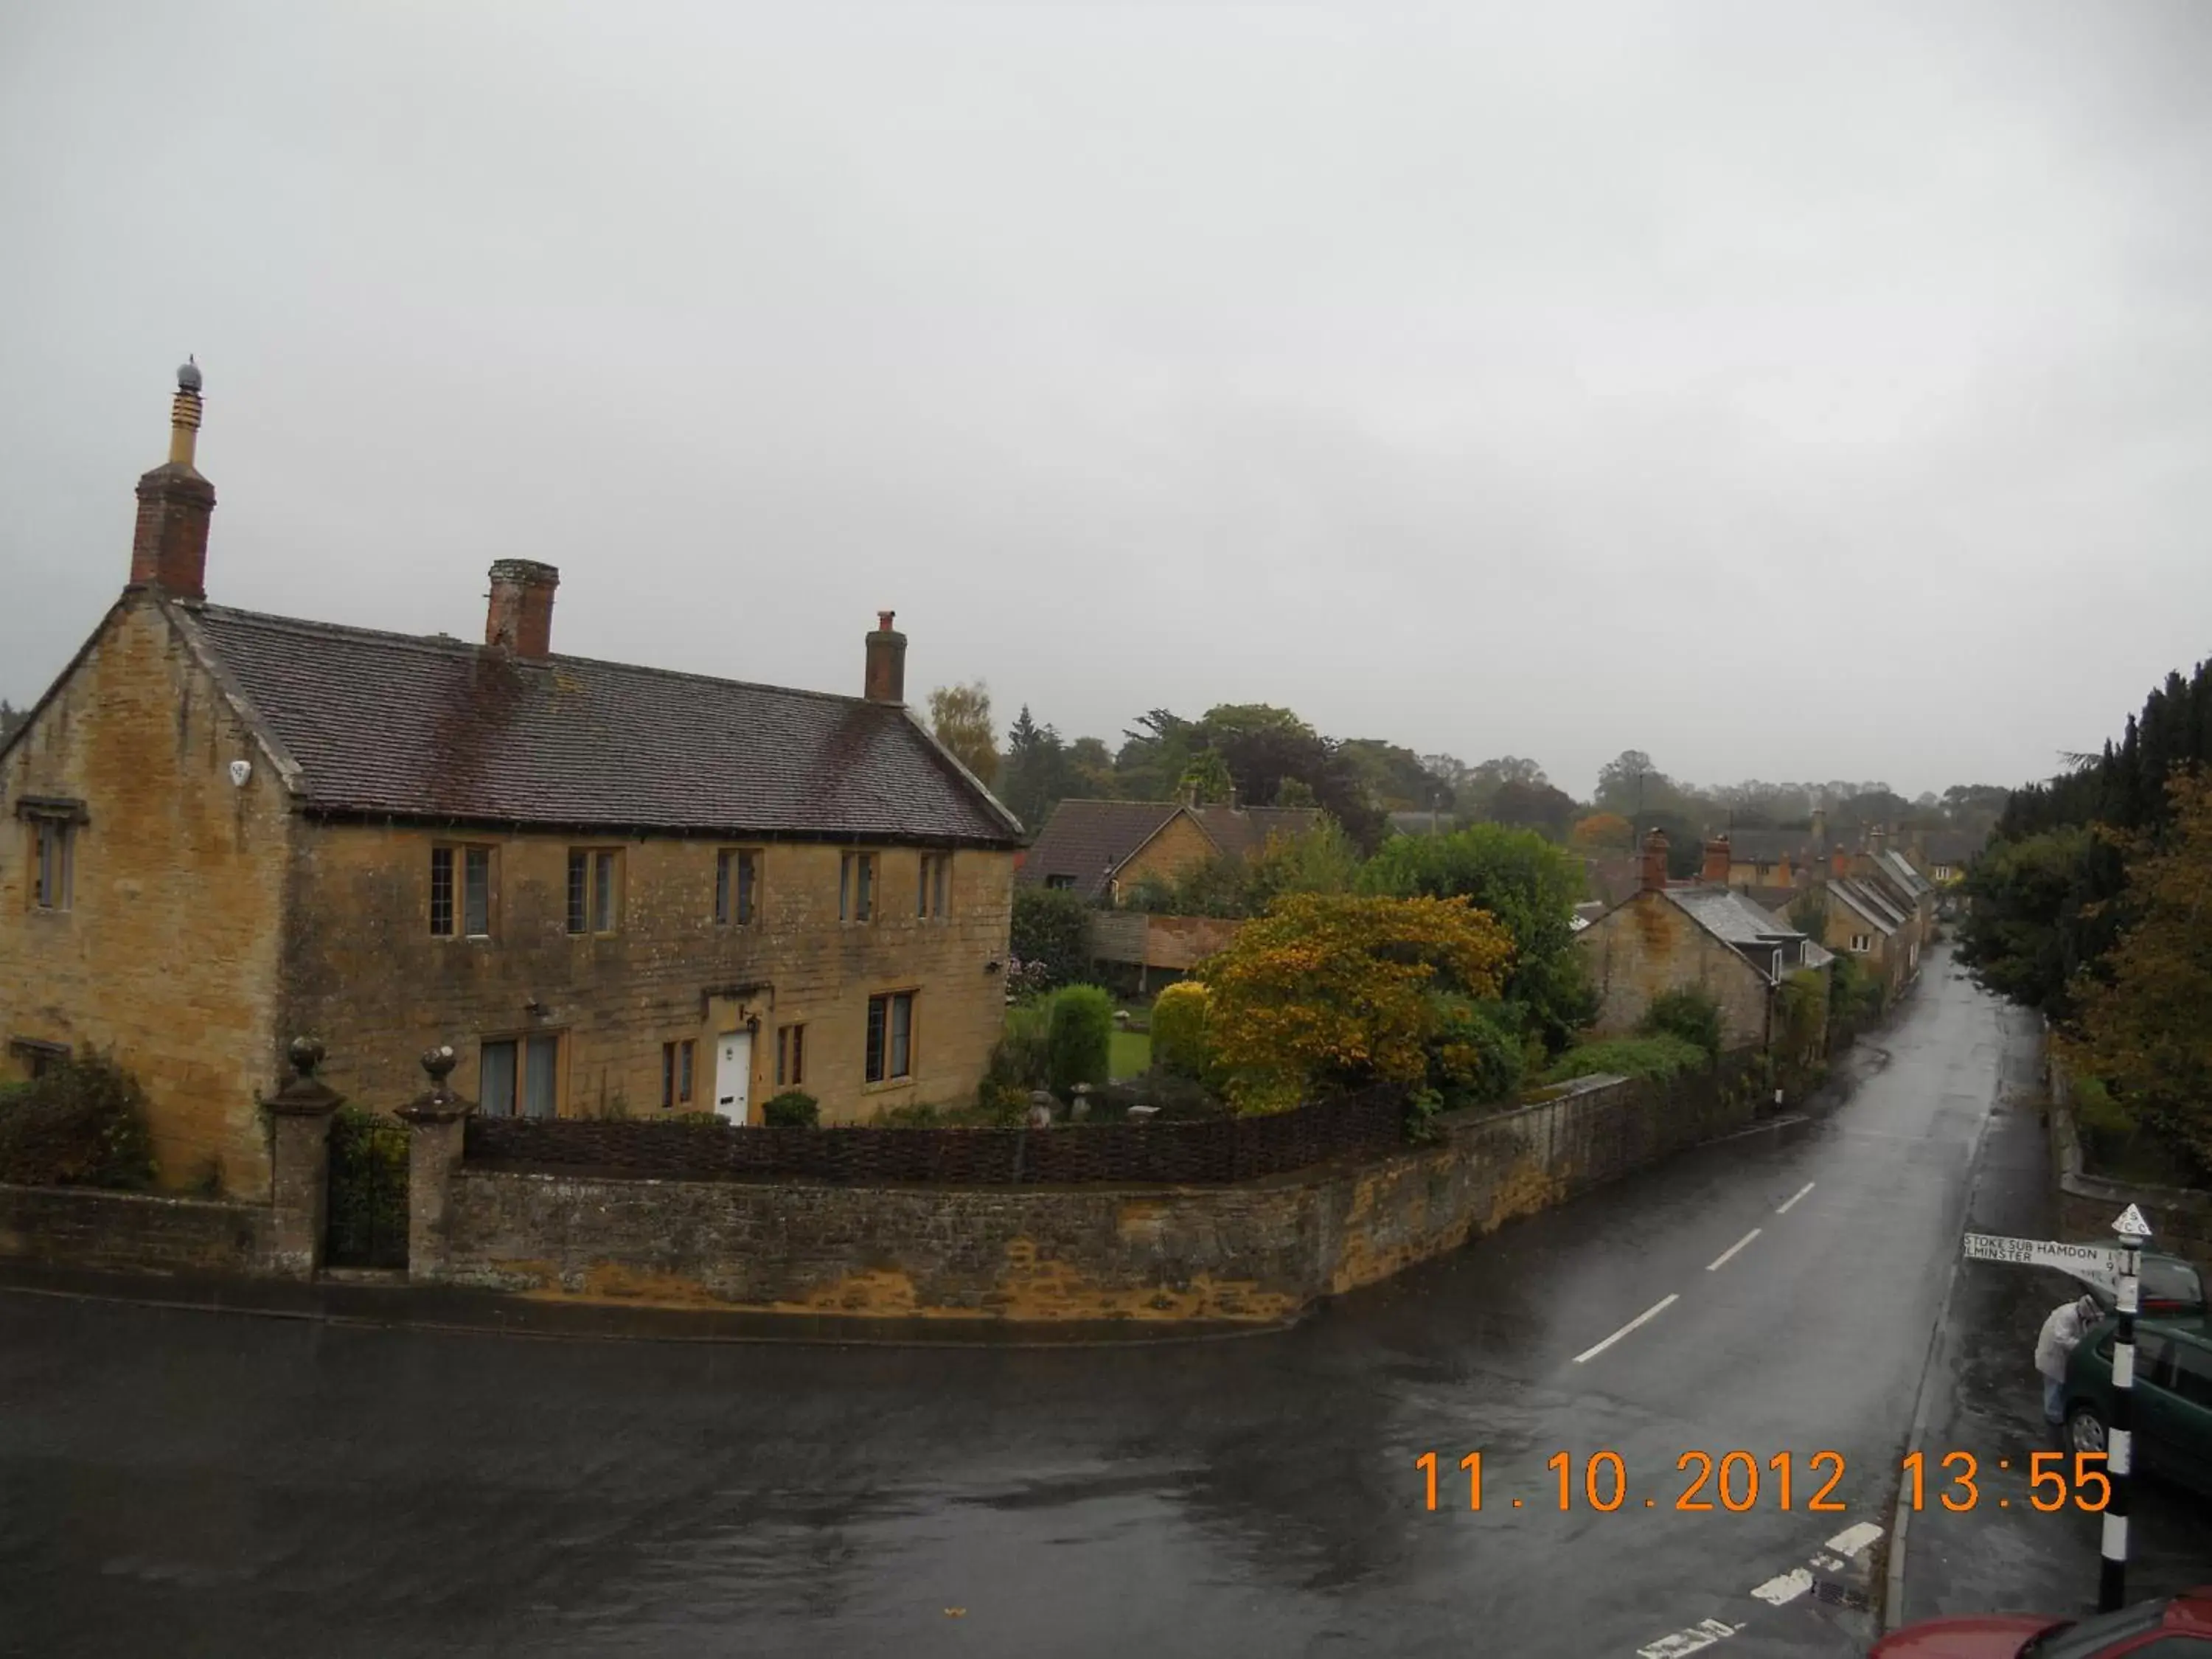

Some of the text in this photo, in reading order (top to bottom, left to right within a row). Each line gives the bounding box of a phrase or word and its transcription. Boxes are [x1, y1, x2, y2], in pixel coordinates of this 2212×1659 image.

[1964, 1236, 2003, 1251] STOKE
[2008, 1240, 2033, 1252] SUB
[2037, 1244, 2098, 1259] HAMDON
[1964, 1247, 2114, 1272] ILMINSTER 9
